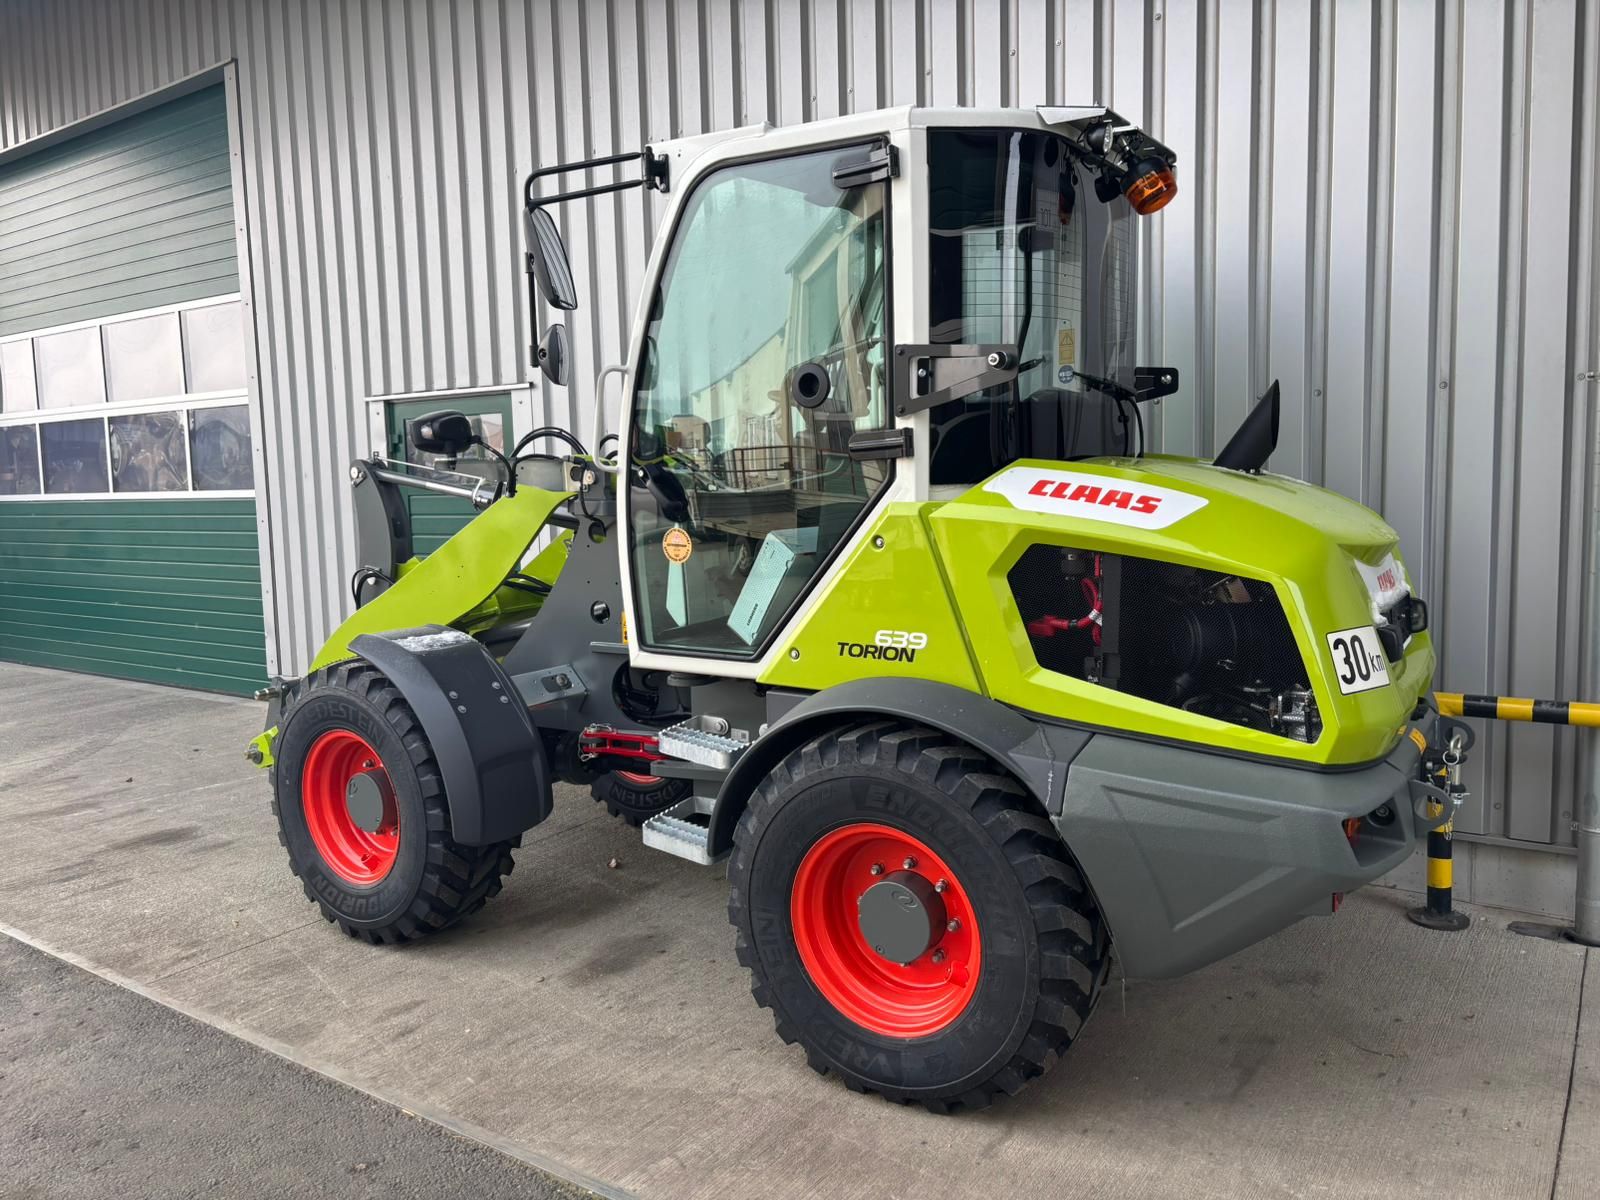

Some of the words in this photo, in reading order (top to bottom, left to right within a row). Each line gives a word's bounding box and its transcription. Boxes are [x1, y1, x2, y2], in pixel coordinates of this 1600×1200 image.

[1028, 479, 1163, 514] CLAAS
[837, 642, 916, 663] TORION
[875, 630, 928, 650] 639
[1333, 635, 1371, 685] 30
[1368, 652, 1386, 673] km
